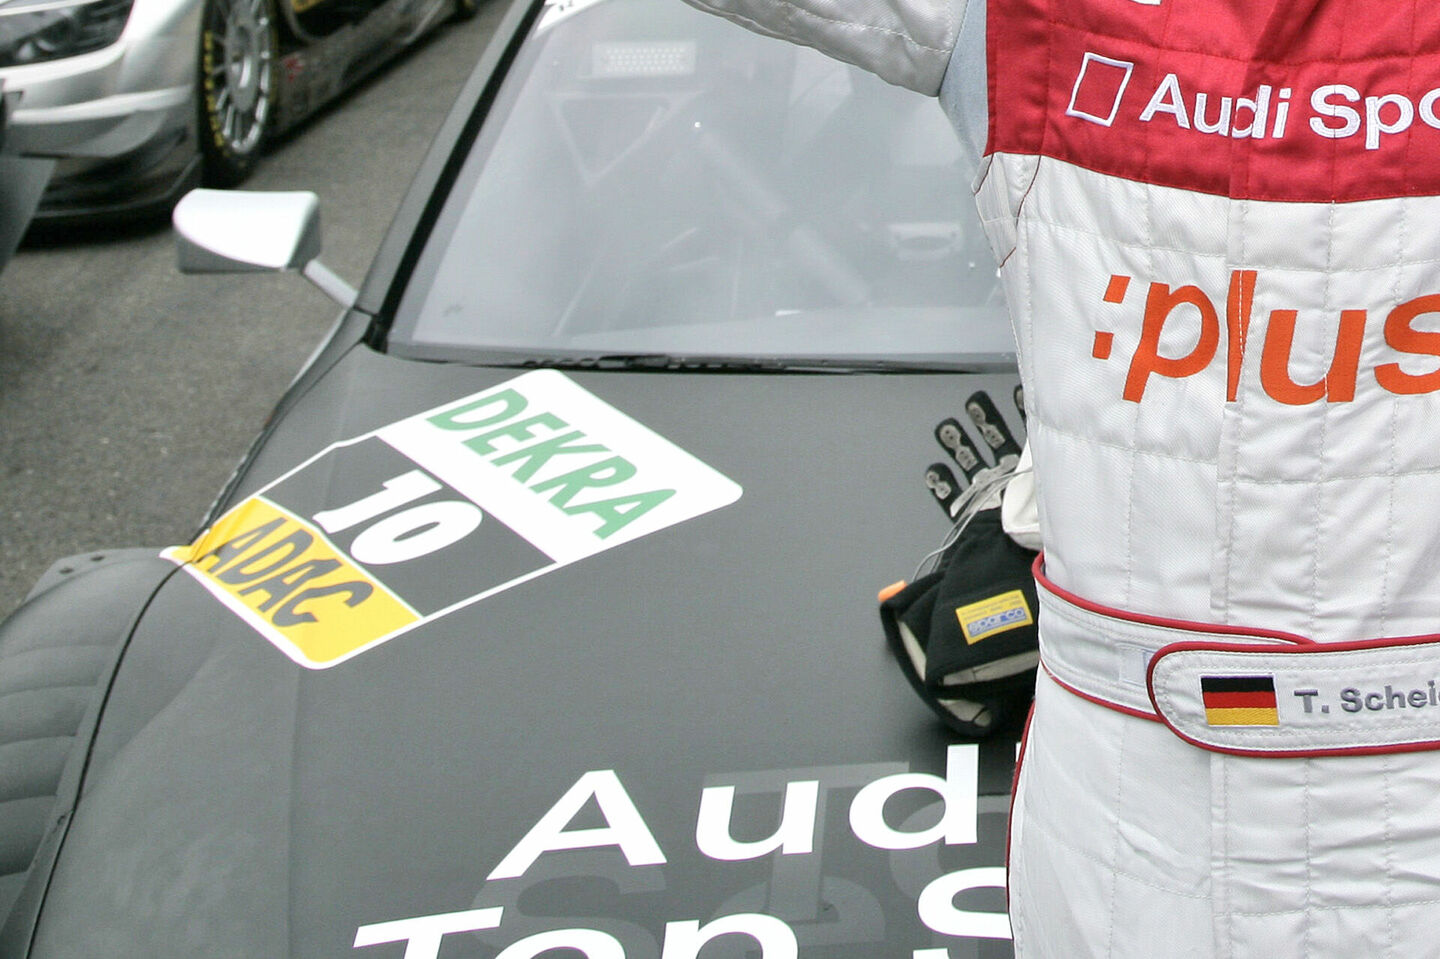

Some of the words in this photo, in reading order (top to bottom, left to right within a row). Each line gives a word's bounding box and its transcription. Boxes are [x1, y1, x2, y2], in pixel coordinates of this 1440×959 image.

[1139, 73, 1292, 139] Audi
[425, 387, 677, 540] DEKRA
[311, 469, 483, 565] 10
[199, 517, 374, 628] ADAC
[967, 607, 1027, 638] sparco
[1294, 690, 1330, 713] T.
[486, 743, 1025, 881] Aud
